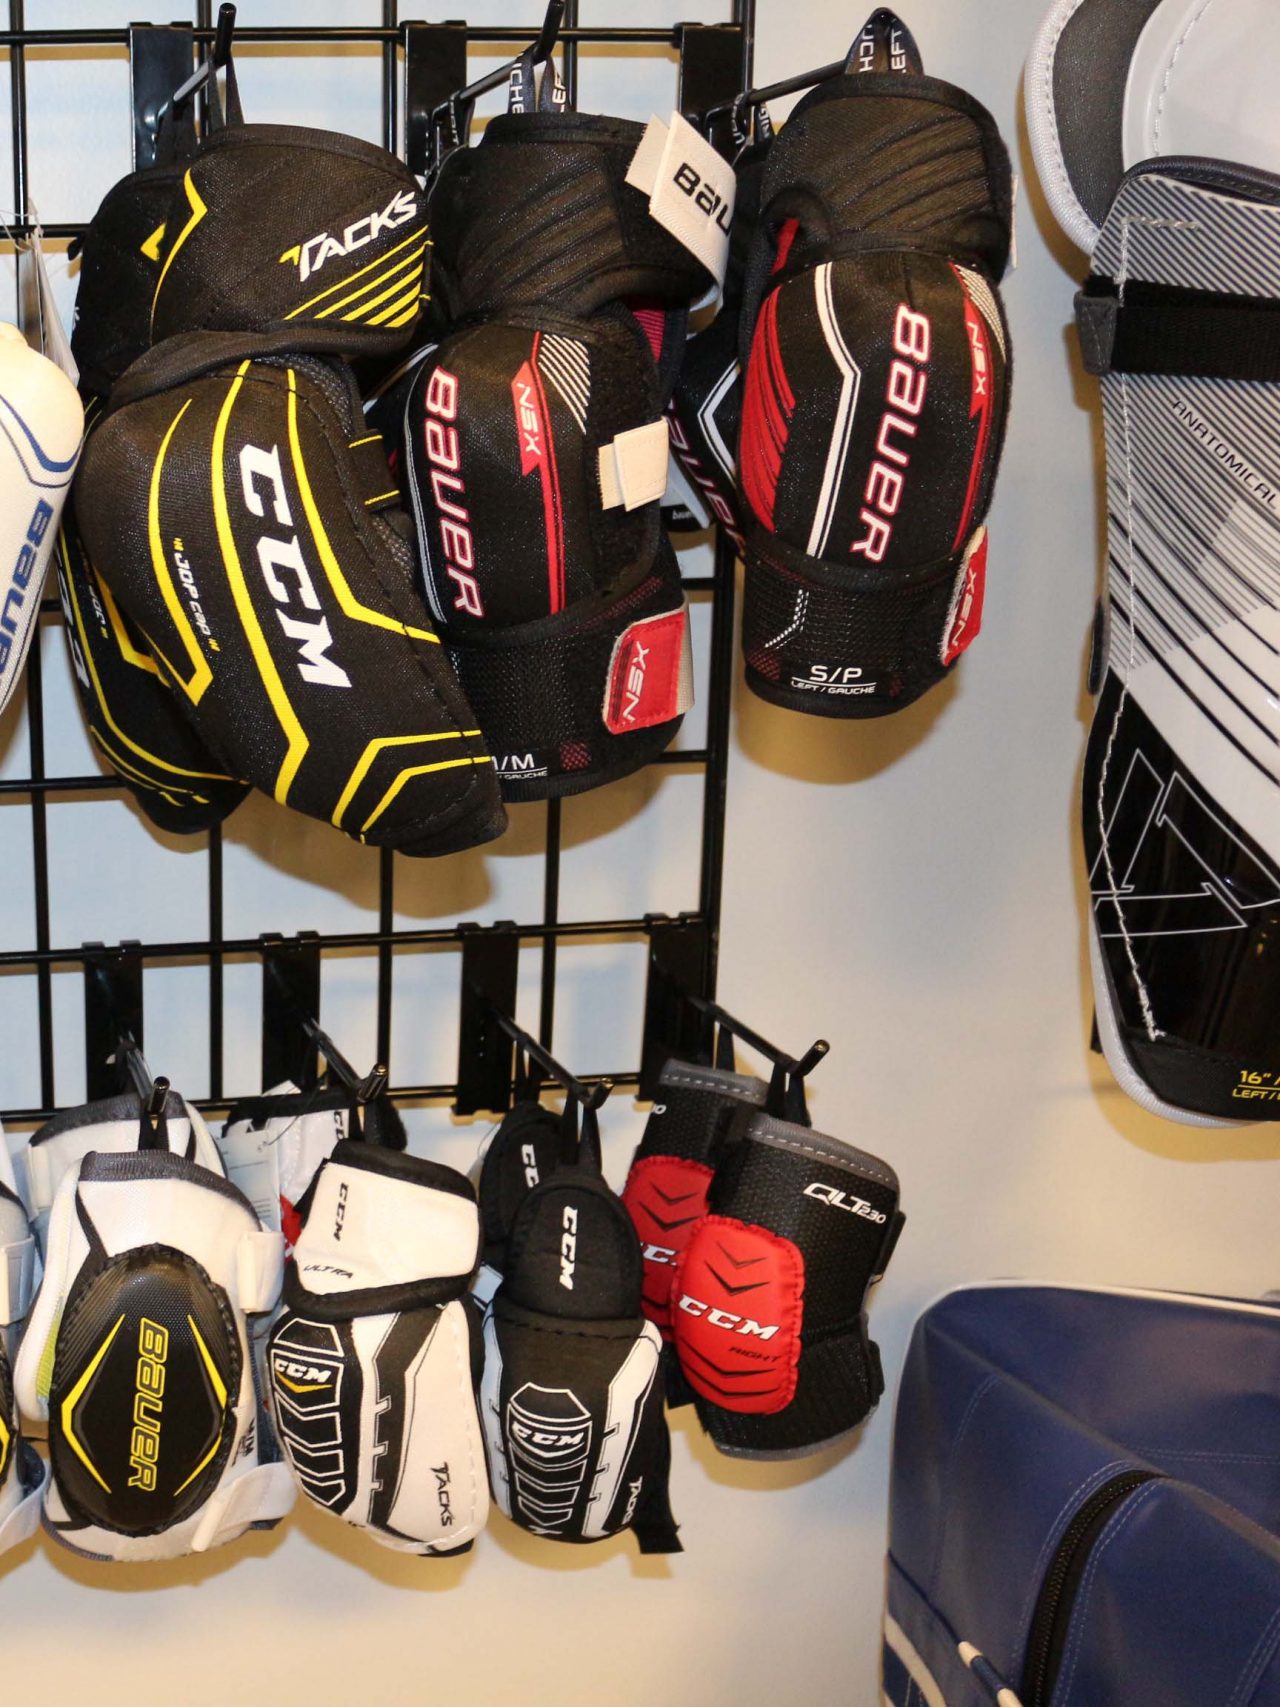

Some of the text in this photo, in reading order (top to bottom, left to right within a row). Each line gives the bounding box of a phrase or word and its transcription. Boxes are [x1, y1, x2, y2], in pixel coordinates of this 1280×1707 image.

[891, 28, 906, 74] EFT
[280, 191, 417, 281] TACKS
[517, 384, 542, 456] NSX
[851, 303, 930, 562] BAUER
[1173, 400, 1277, 510] ANATOMICAL
[426, 367, 485, 618] BAUER
[239, 444, 352, 688] CCM
[622, 643, 650, 723] NSX
[790, 680, 819, 692] LEFT
[827, 686, 876, 695] GAUCHE
[809, 665, 863, 684] S/P
[333, 1182, 349, 1242] CCM
[559, 1206, 578, 1291] CCM
[679, 1293, 781, 1341] CCM
[128, 1317, 168, 1493] BAUER
[275, 1358, 334, 1384] CCM
[511, 1420, 585, 1447] CCM
[430, 1461, 454, 1526] TACKS
